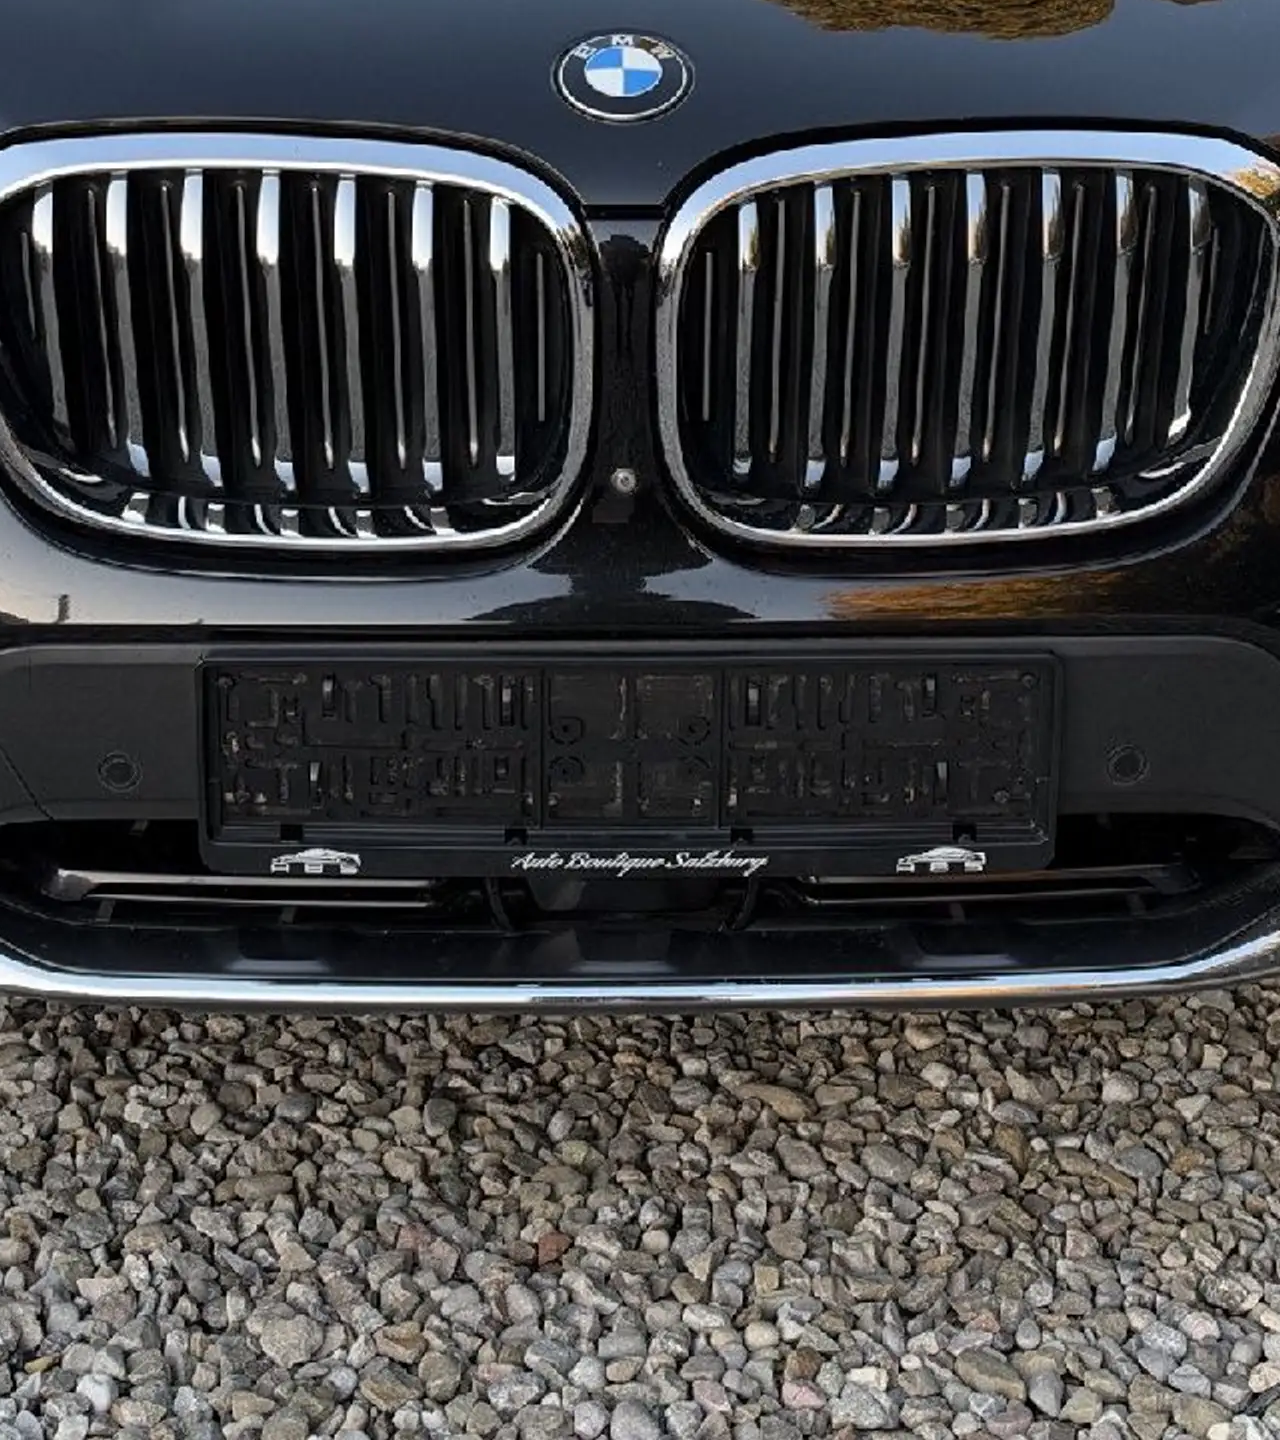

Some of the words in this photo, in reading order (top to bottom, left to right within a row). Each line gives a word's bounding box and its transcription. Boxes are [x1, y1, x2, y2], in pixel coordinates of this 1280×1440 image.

[573, 33, 676, 61] BMW
[511, 851, 563, 871] Auto
[564, 851, 665, 878] Boutique
[664, 849, 770, 878] Salzburg
